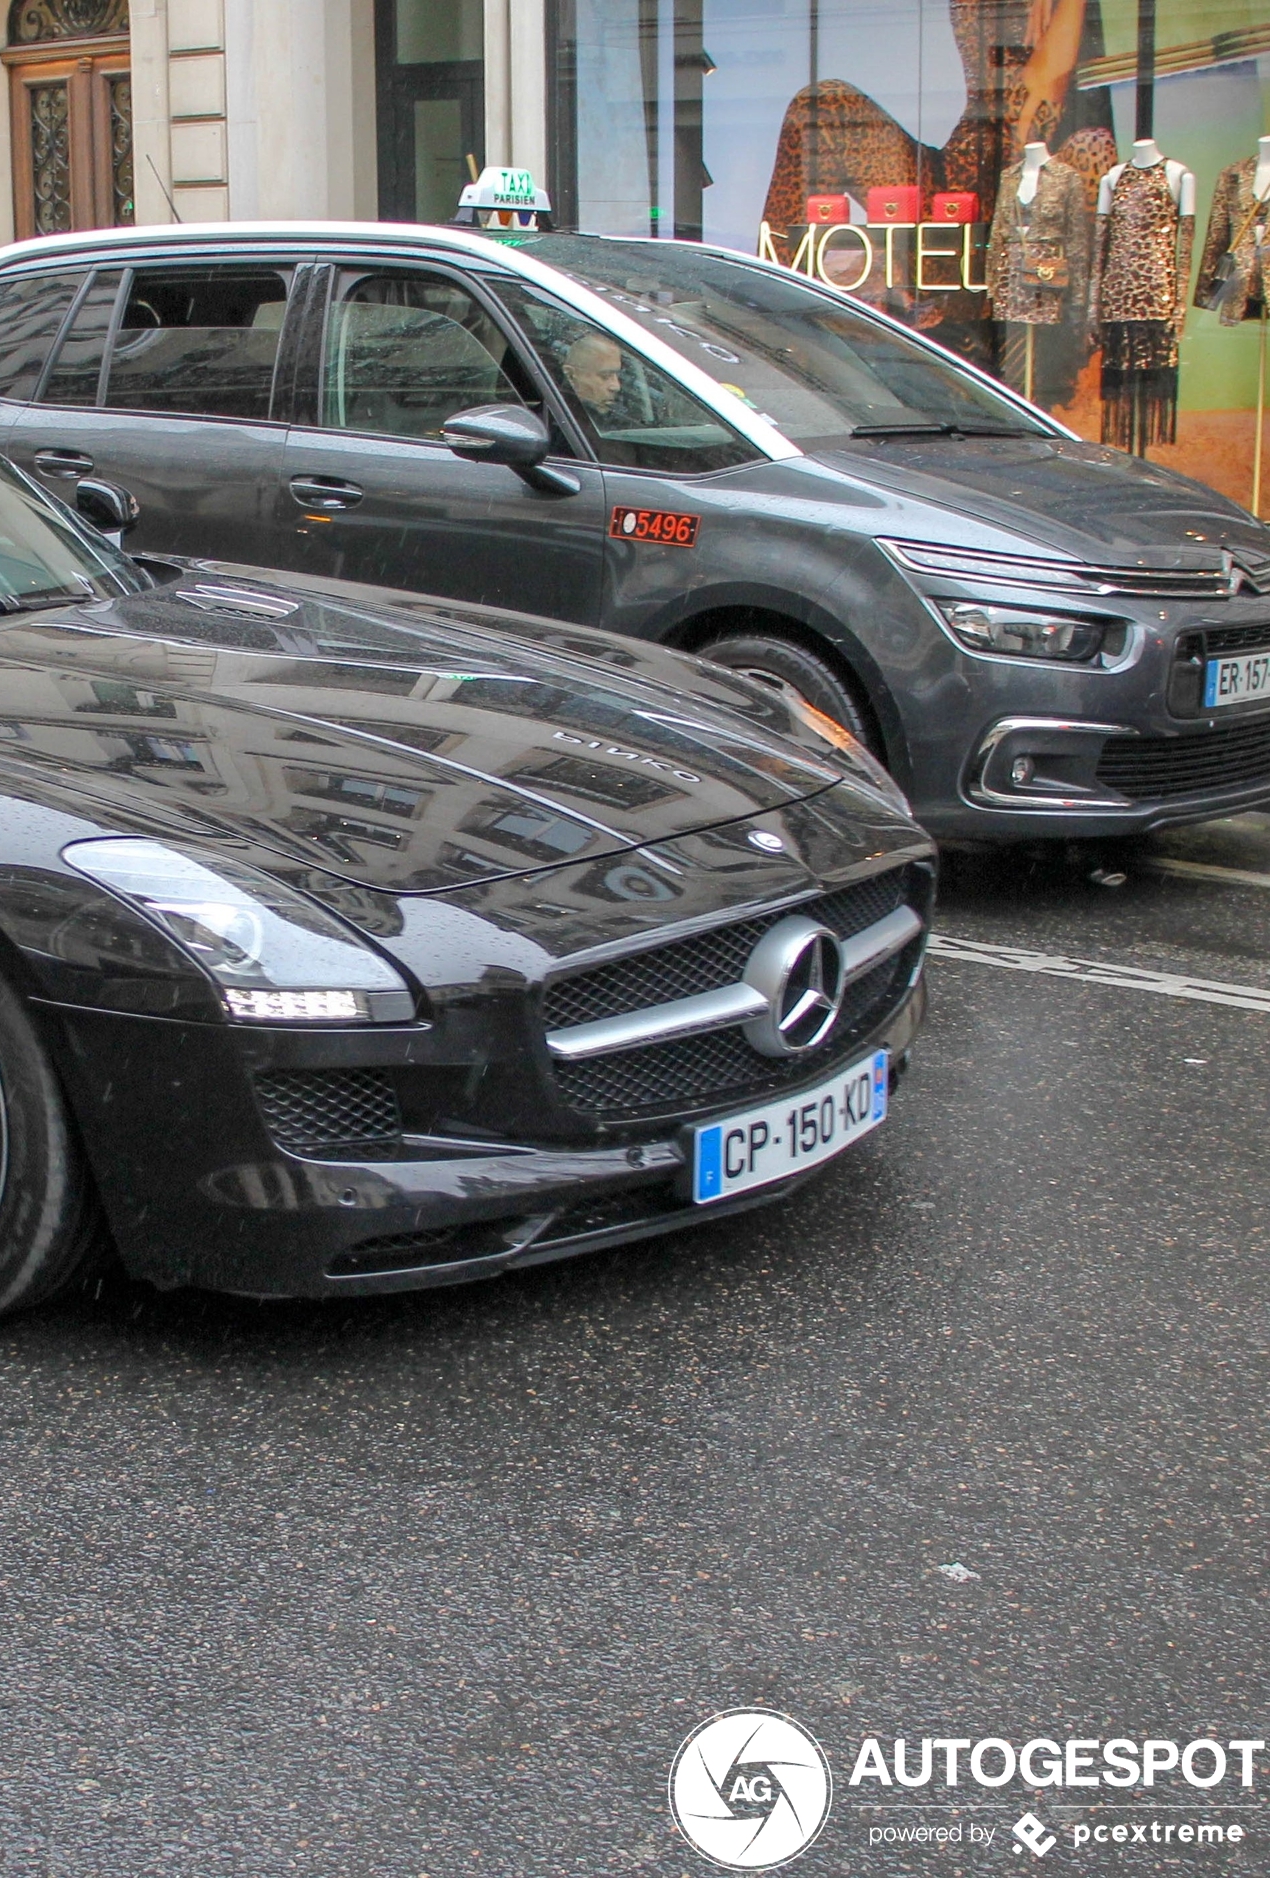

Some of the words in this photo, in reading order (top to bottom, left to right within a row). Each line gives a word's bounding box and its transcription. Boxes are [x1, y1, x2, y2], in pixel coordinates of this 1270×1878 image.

[500, 172, 533, 195] TAXI
[494, 194, 536, 206] PARISIEN
[759, 220, 989, 292] MOTEL
[635, 512, 692, 542] 5496
[724, 1072, 872, 1179] CP-150-KD
